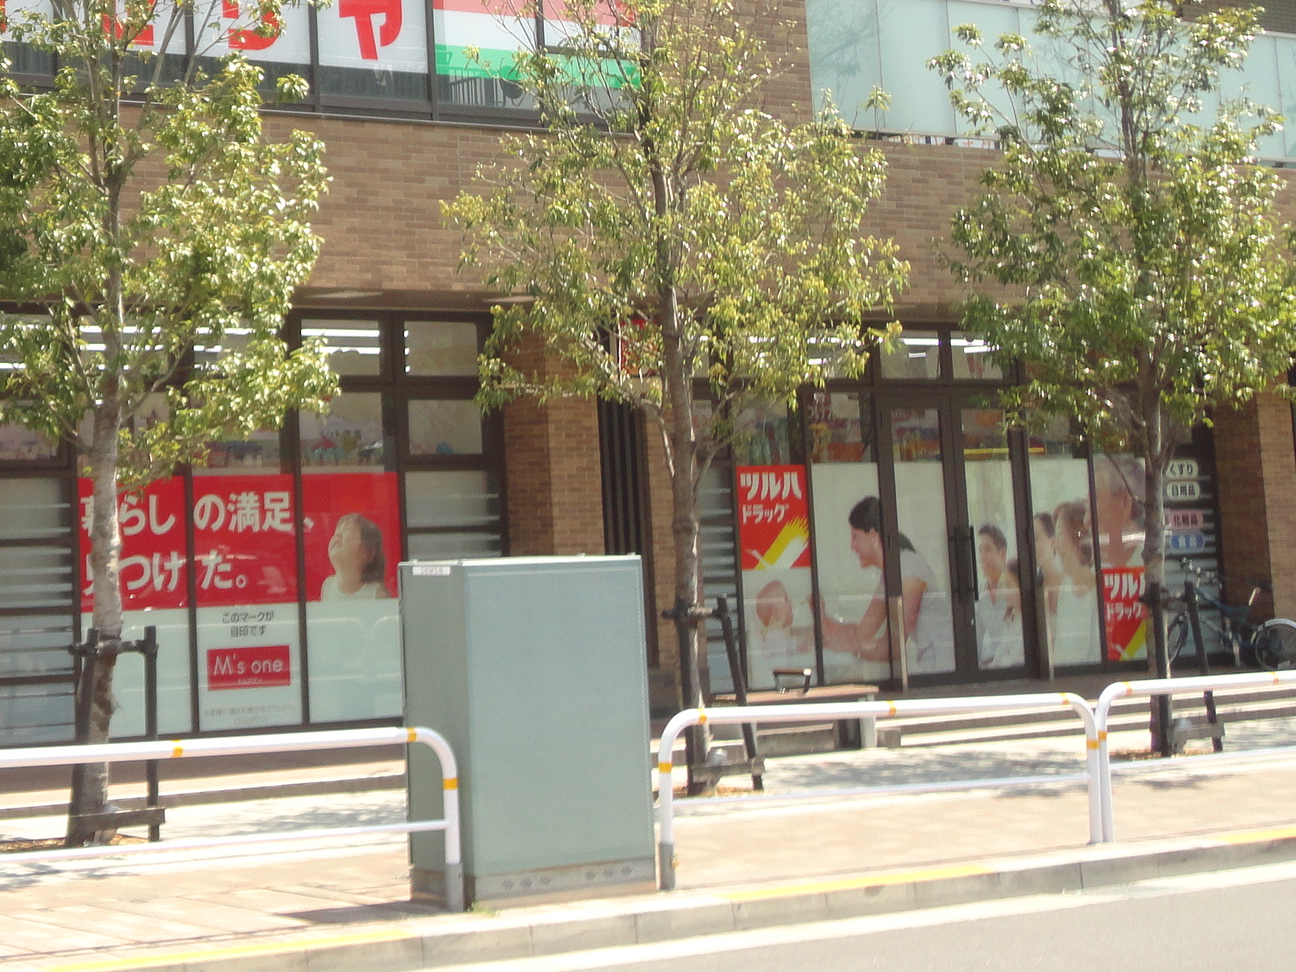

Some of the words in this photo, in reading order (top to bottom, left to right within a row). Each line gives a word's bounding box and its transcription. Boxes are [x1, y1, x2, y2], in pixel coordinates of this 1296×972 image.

[740, 472, 802, 501] ツルハ
[742, 503, 789, 524] ドラッグ
[222, 610, 274, 624] このマークが
[230, 626, 266, 638] 目印です
[213, 654, 245, 677] M's
[250, 659, 283, 674] one
